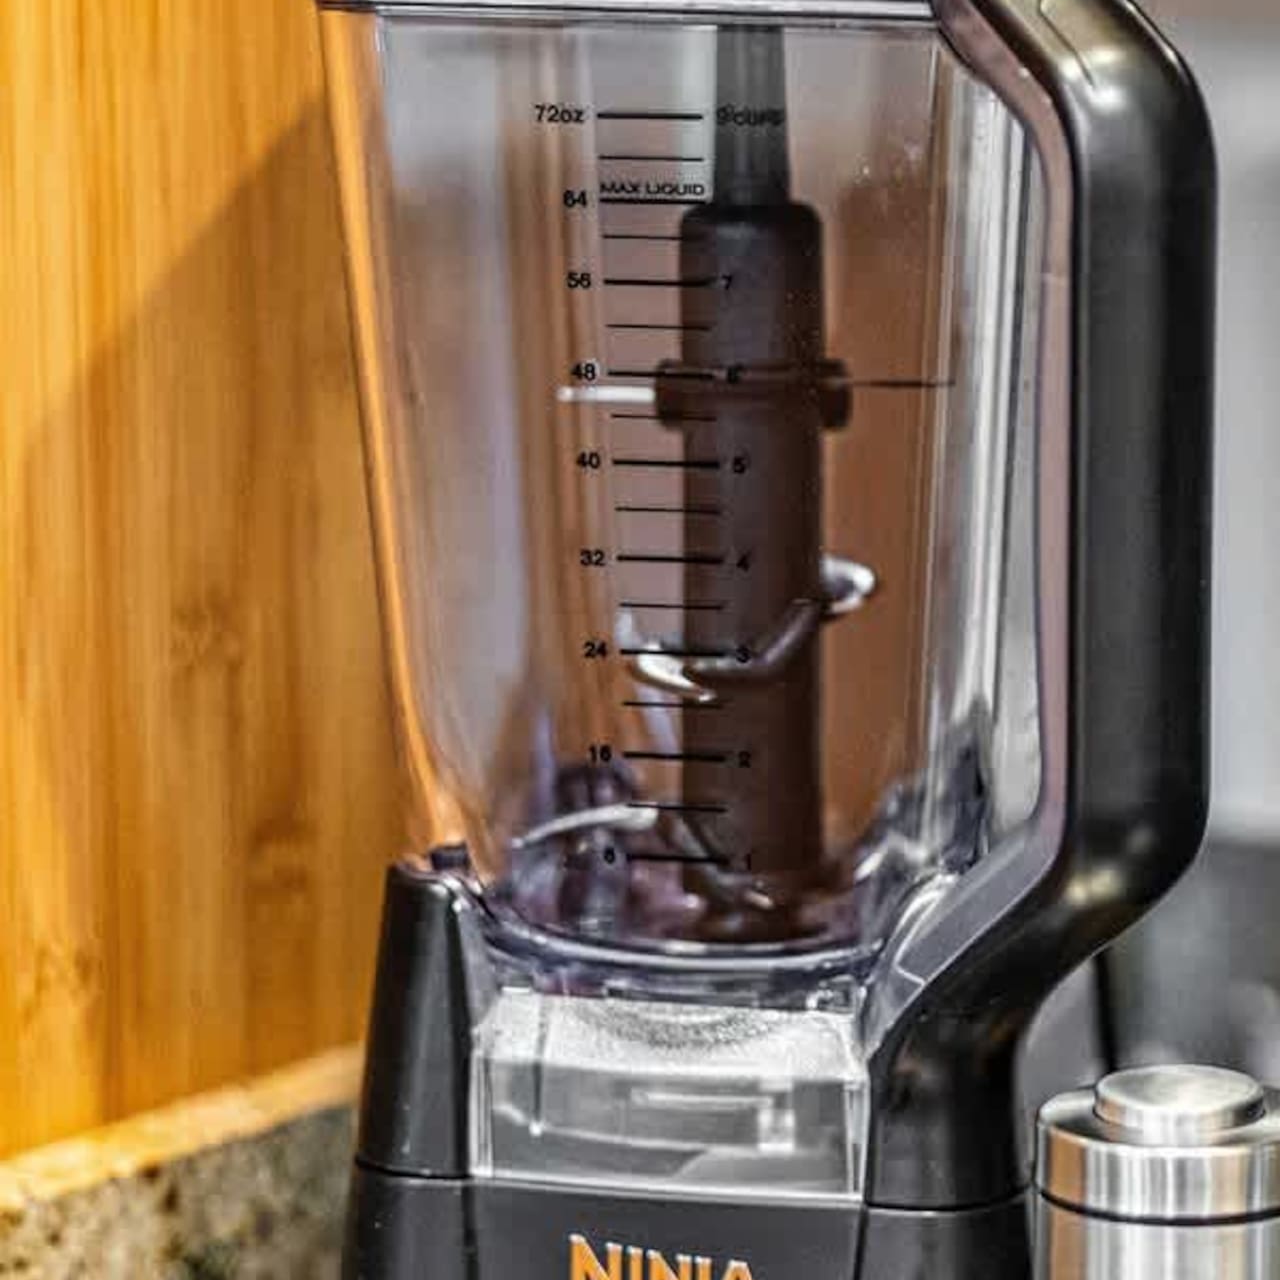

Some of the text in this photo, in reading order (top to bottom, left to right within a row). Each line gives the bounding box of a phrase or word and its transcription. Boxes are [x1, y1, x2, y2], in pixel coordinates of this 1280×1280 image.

[534, 105, 585, 124] 72oz
[563, 190, 588, 208] 64
[600, 182, 705, 197] MAX LIQUID
[566, 272, 592, 290] 56
[571, 363, 596, 381] 48
[576, 452, 601, 471] 40
[733, 456, 747, 475] 5
[580, 548, 605, 567] 32
[736, 554, 751, 572] 4
[584, 641, 608, 660] 24
[736, 644, 751, 663] 3
[588, 745, 611, 764] 16
